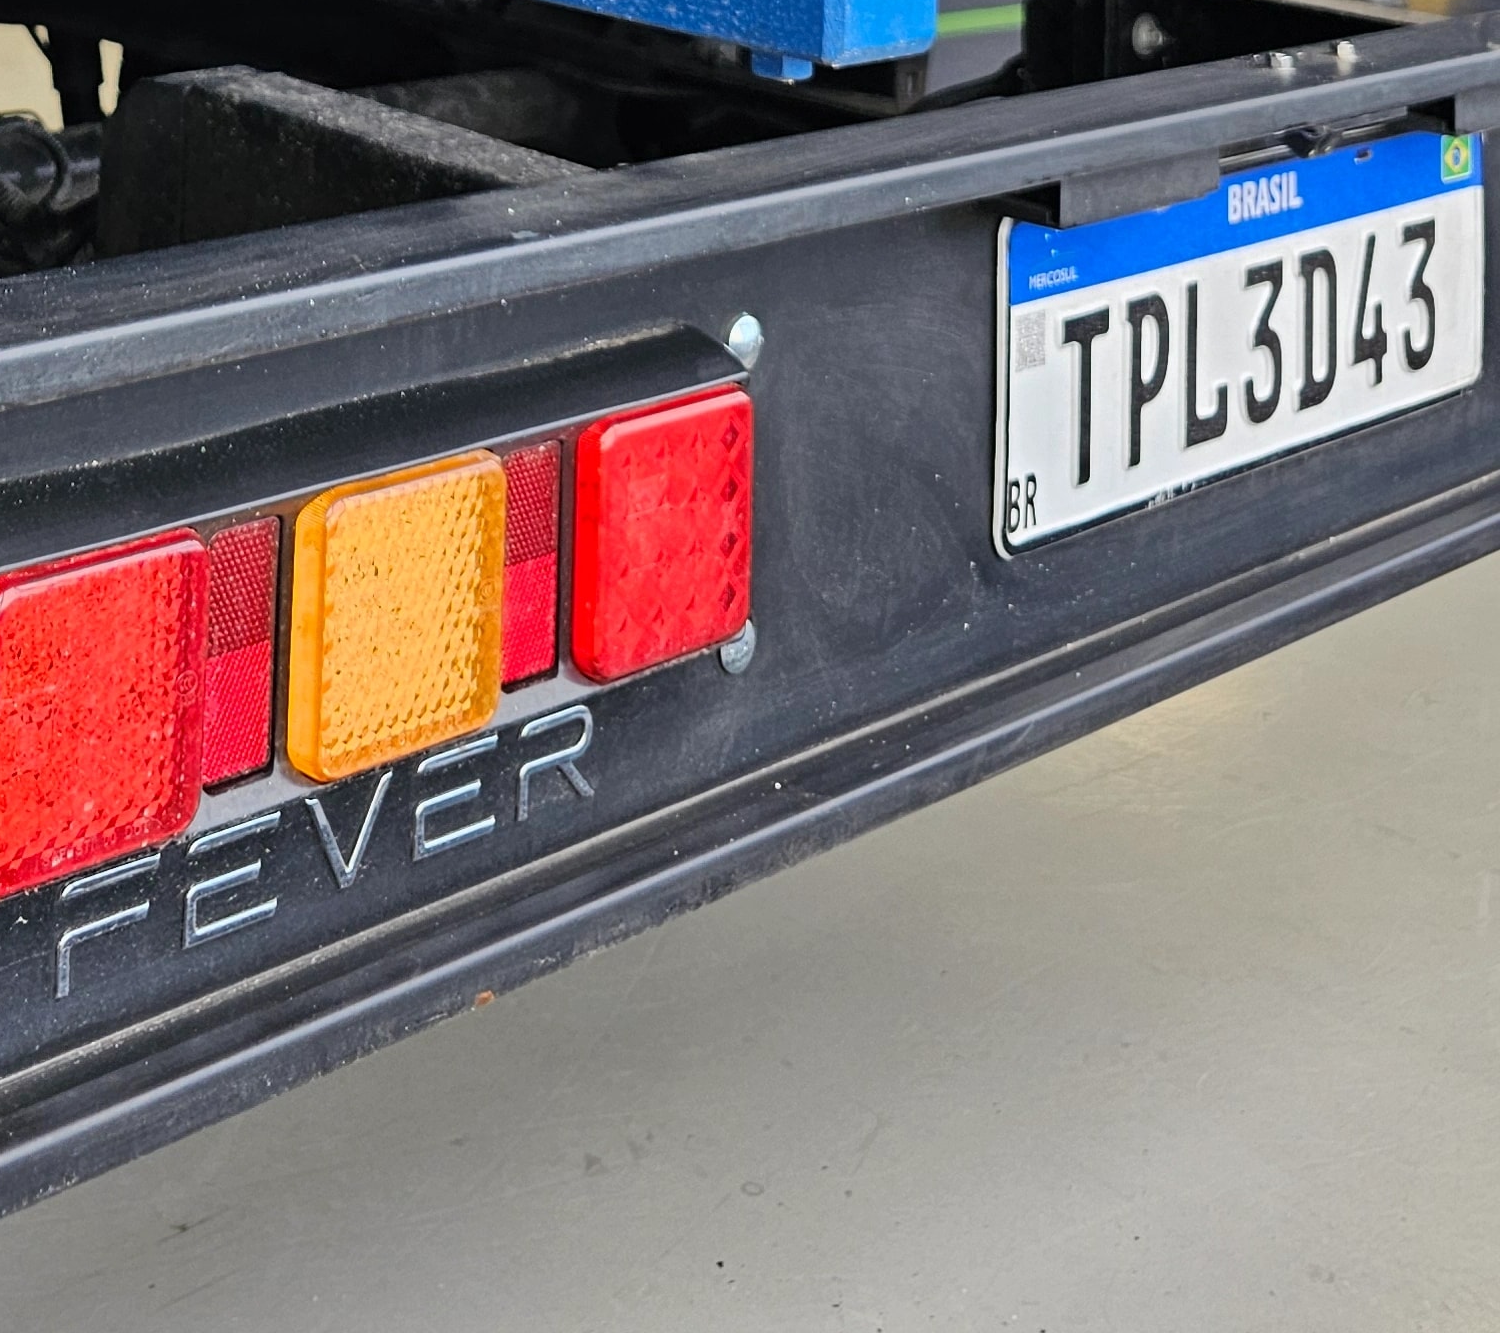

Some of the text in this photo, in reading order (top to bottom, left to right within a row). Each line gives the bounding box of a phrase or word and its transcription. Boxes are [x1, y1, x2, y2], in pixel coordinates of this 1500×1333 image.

[1228, 171, 1304, 224] BRASIL
[1028, 265, 1080, 291] MERCOSUL
[1060, 217, 1437, 487] TPL3D43
[1007, 474, 1038, 534] BR
[54, 704, 595, 999] FEVER
